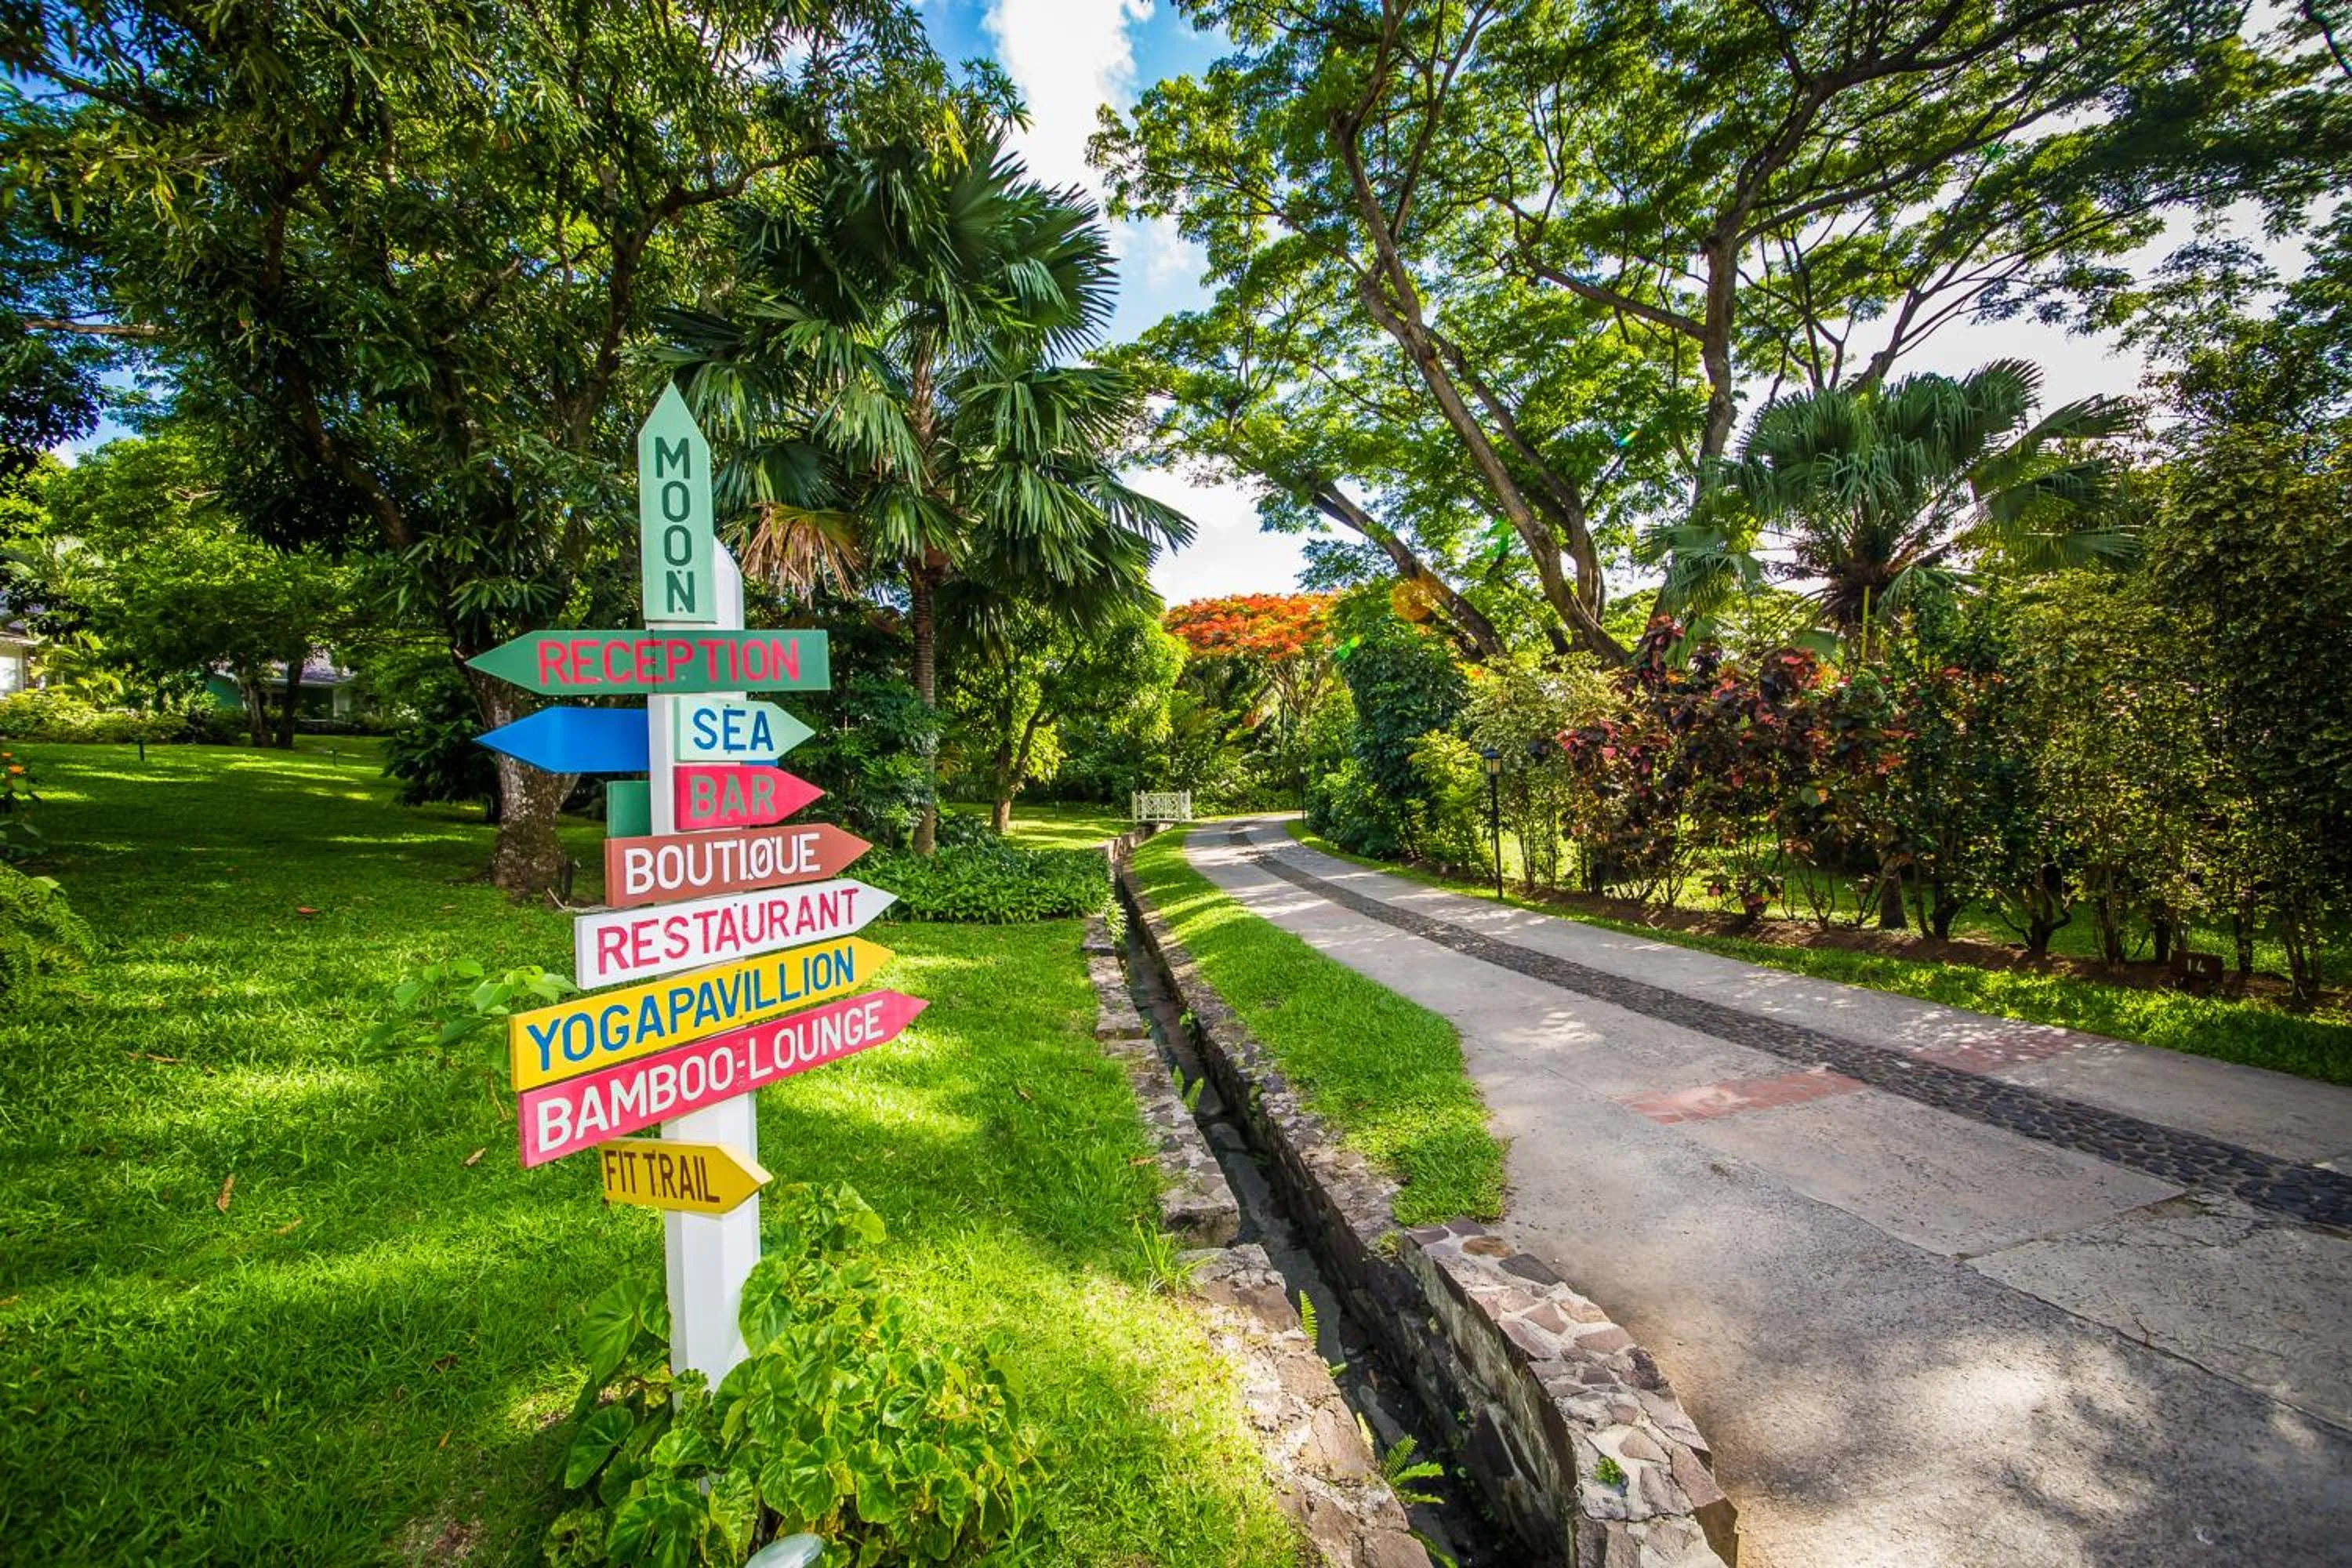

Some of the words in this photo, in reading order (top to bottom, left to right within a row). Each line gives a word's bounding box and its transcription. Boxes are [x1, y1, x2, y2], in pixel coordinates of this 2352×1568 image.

[655, 437, 695, 613] MOON
[537, 640, 800, 685] RECEPTION
[692, 708, 773, 752] SEA
[690, 775, 776, 818] BAR
[597, 887, 859, 975] RESTAURANT
[604, 1150, 637, 1191] FIT
[643, 1152, 720, 1203] TRAIL
